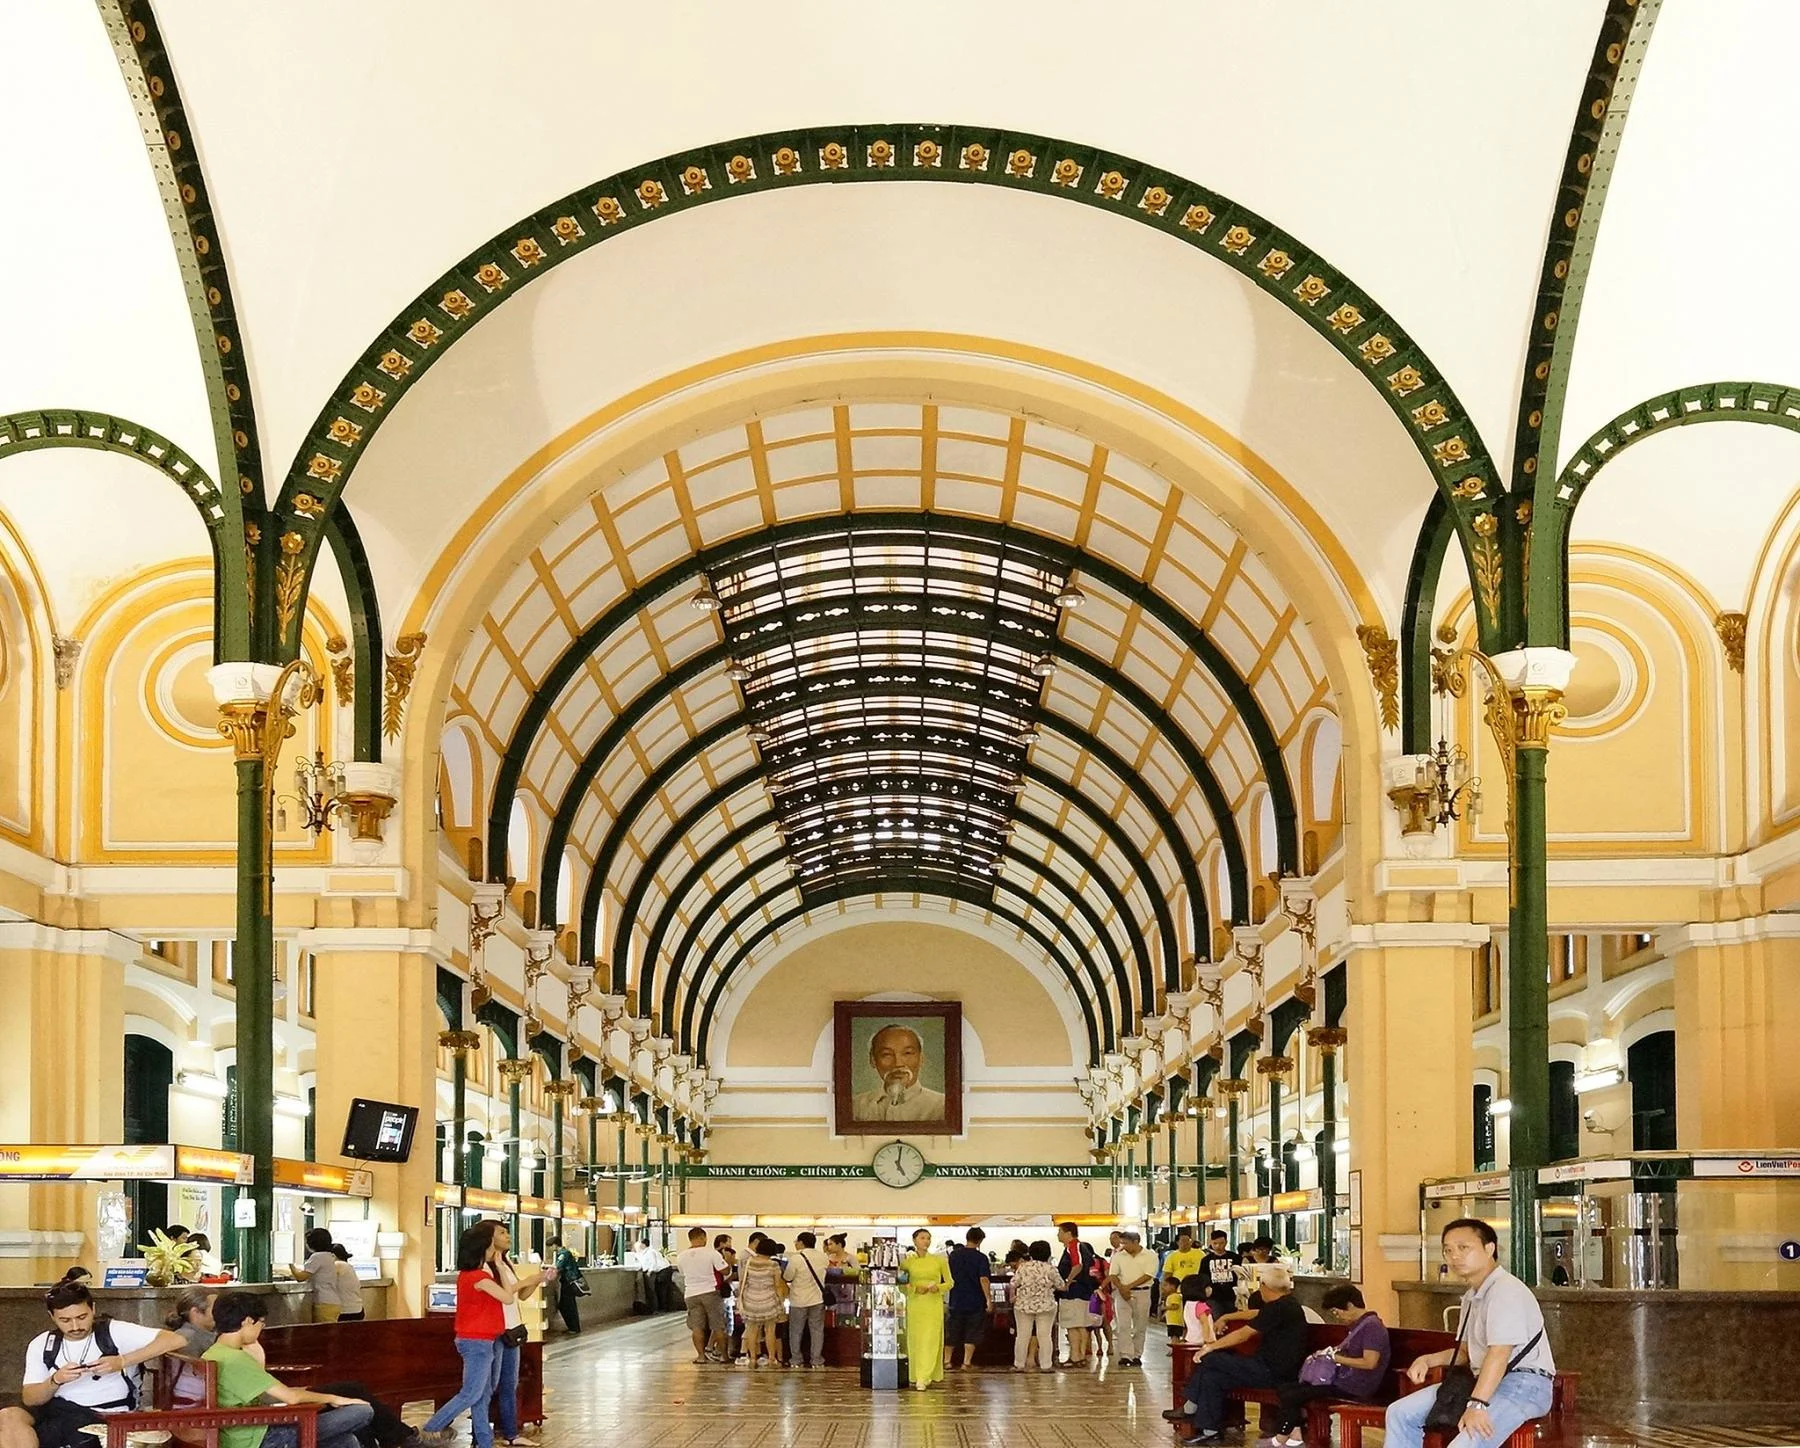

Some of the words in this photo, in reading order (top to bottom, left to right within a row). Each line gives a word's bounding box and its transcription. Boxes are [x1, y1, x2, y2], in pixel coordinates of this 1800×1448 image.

[708, 1167, 745, 1176] NHANH
[748, 1165, 787, 1176] CHÓNG
[800, 1165, 836, 1176] CHÍNH
[840, 1165, 864, 1176] XÁC
[934, 1167, 949, 1176] AN
[950, 1165, 979, 1176] TOÀN
[1063, 1167, 1092, 1176] MINH
[1557, 1244, 1562, 1257] 2
[1786, 1245, 1794, 1258] 1
